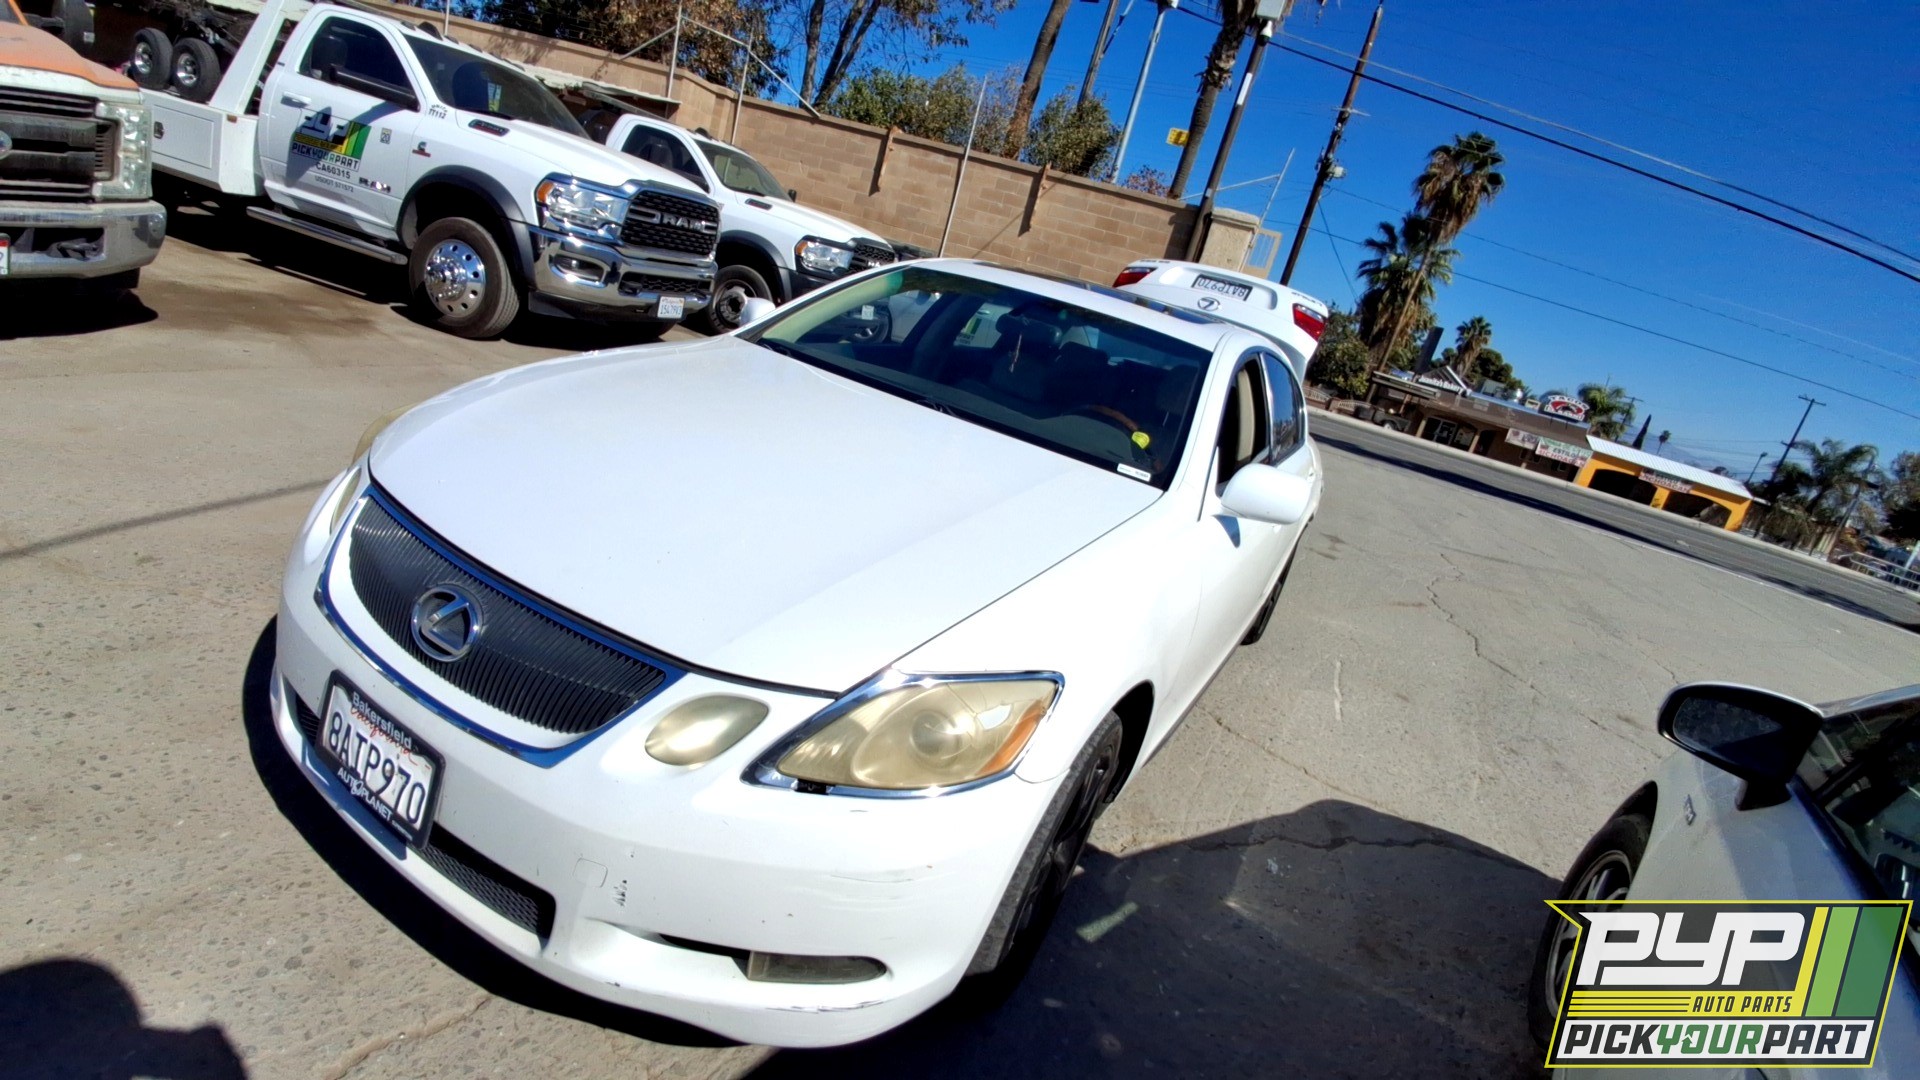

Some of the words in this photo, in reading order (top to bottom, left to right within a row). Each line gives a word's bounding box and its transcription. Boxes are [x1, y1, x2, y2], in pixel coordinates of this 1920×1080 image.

[292, 142, 359, 170] PICKYOURPART
[662, 212, 704, 232] RAM
[1548, 394, 1590, 411] TACOS
[352, 691, 412, 749] Bakersfield
[328, 711, 427, 825] 8ATP970
